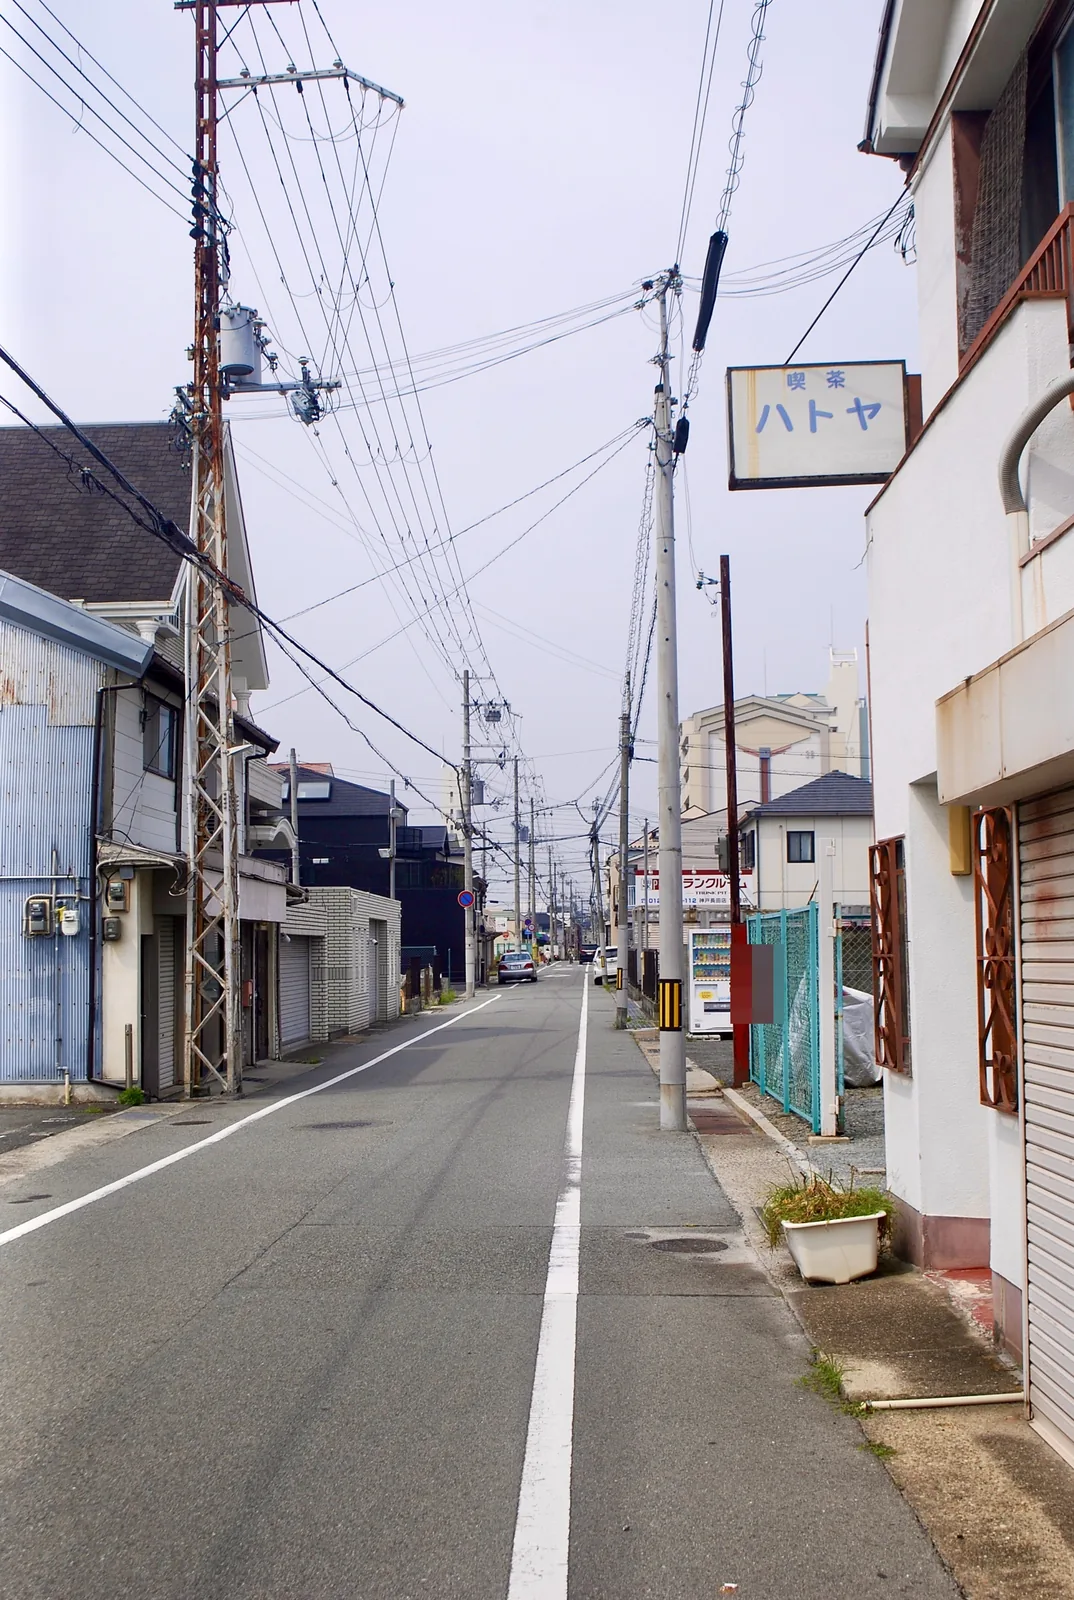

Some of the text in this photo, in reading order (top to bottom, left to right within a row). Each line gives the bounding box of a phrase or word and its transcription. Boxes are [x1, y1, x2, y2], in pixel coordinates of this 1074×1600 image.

[787, 370, 846, 391] 喫茶
[755, 397, 882, 434] ハトヤ
